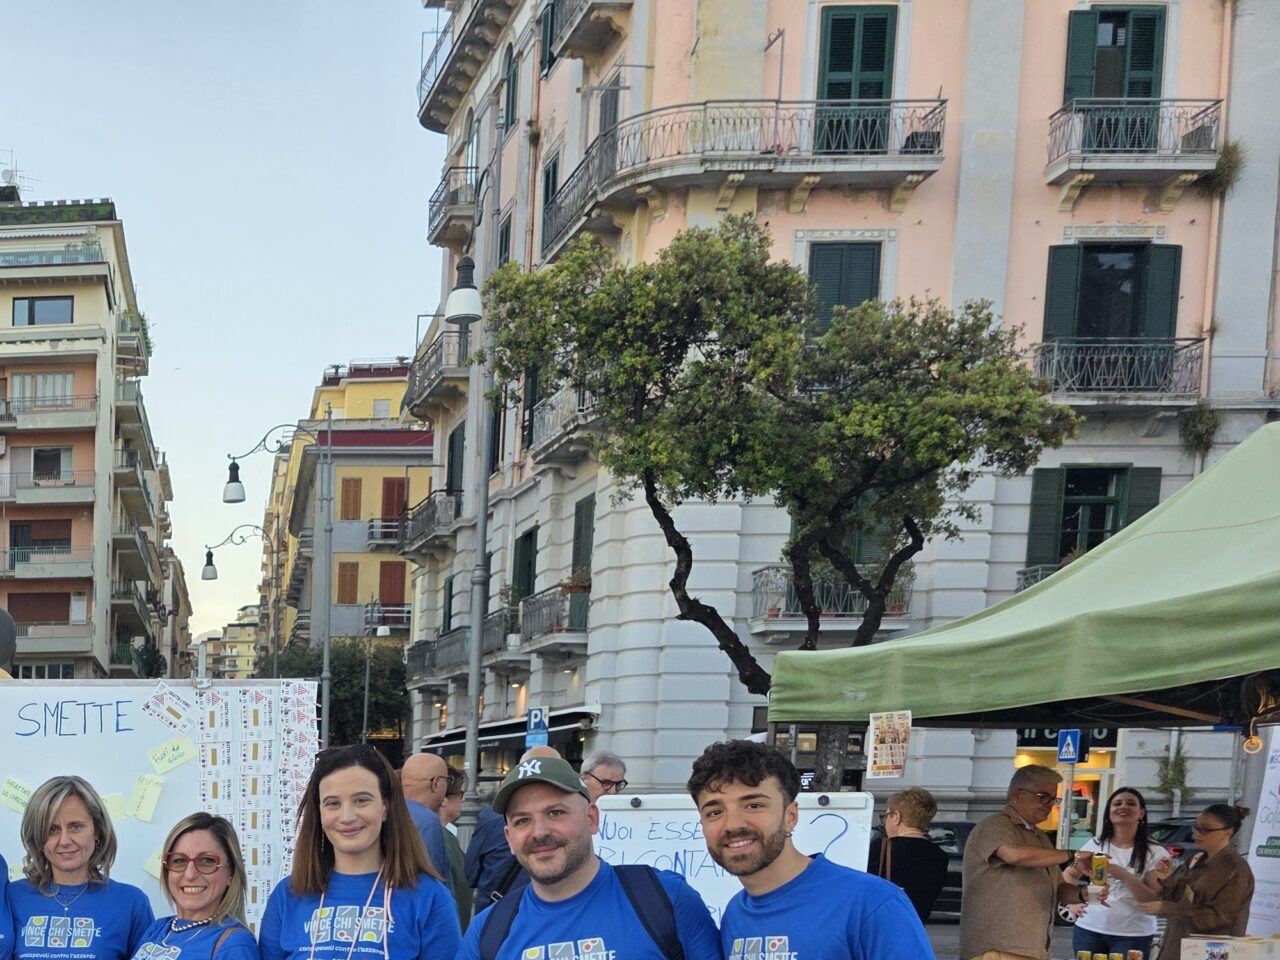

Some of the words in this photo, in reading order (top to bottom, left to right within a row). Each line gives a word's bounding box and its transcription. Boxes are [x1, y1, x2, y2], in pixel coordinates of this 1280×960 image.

[16, 700, 134, 736] SMETTE
[531, 710, 541, 728] P
[518, 760, 542, 778] NY
[334, 917, 351, 928] CHI
[48, 928, 64, 937] CHI
[66, 927, 102, 937] SMETTE
